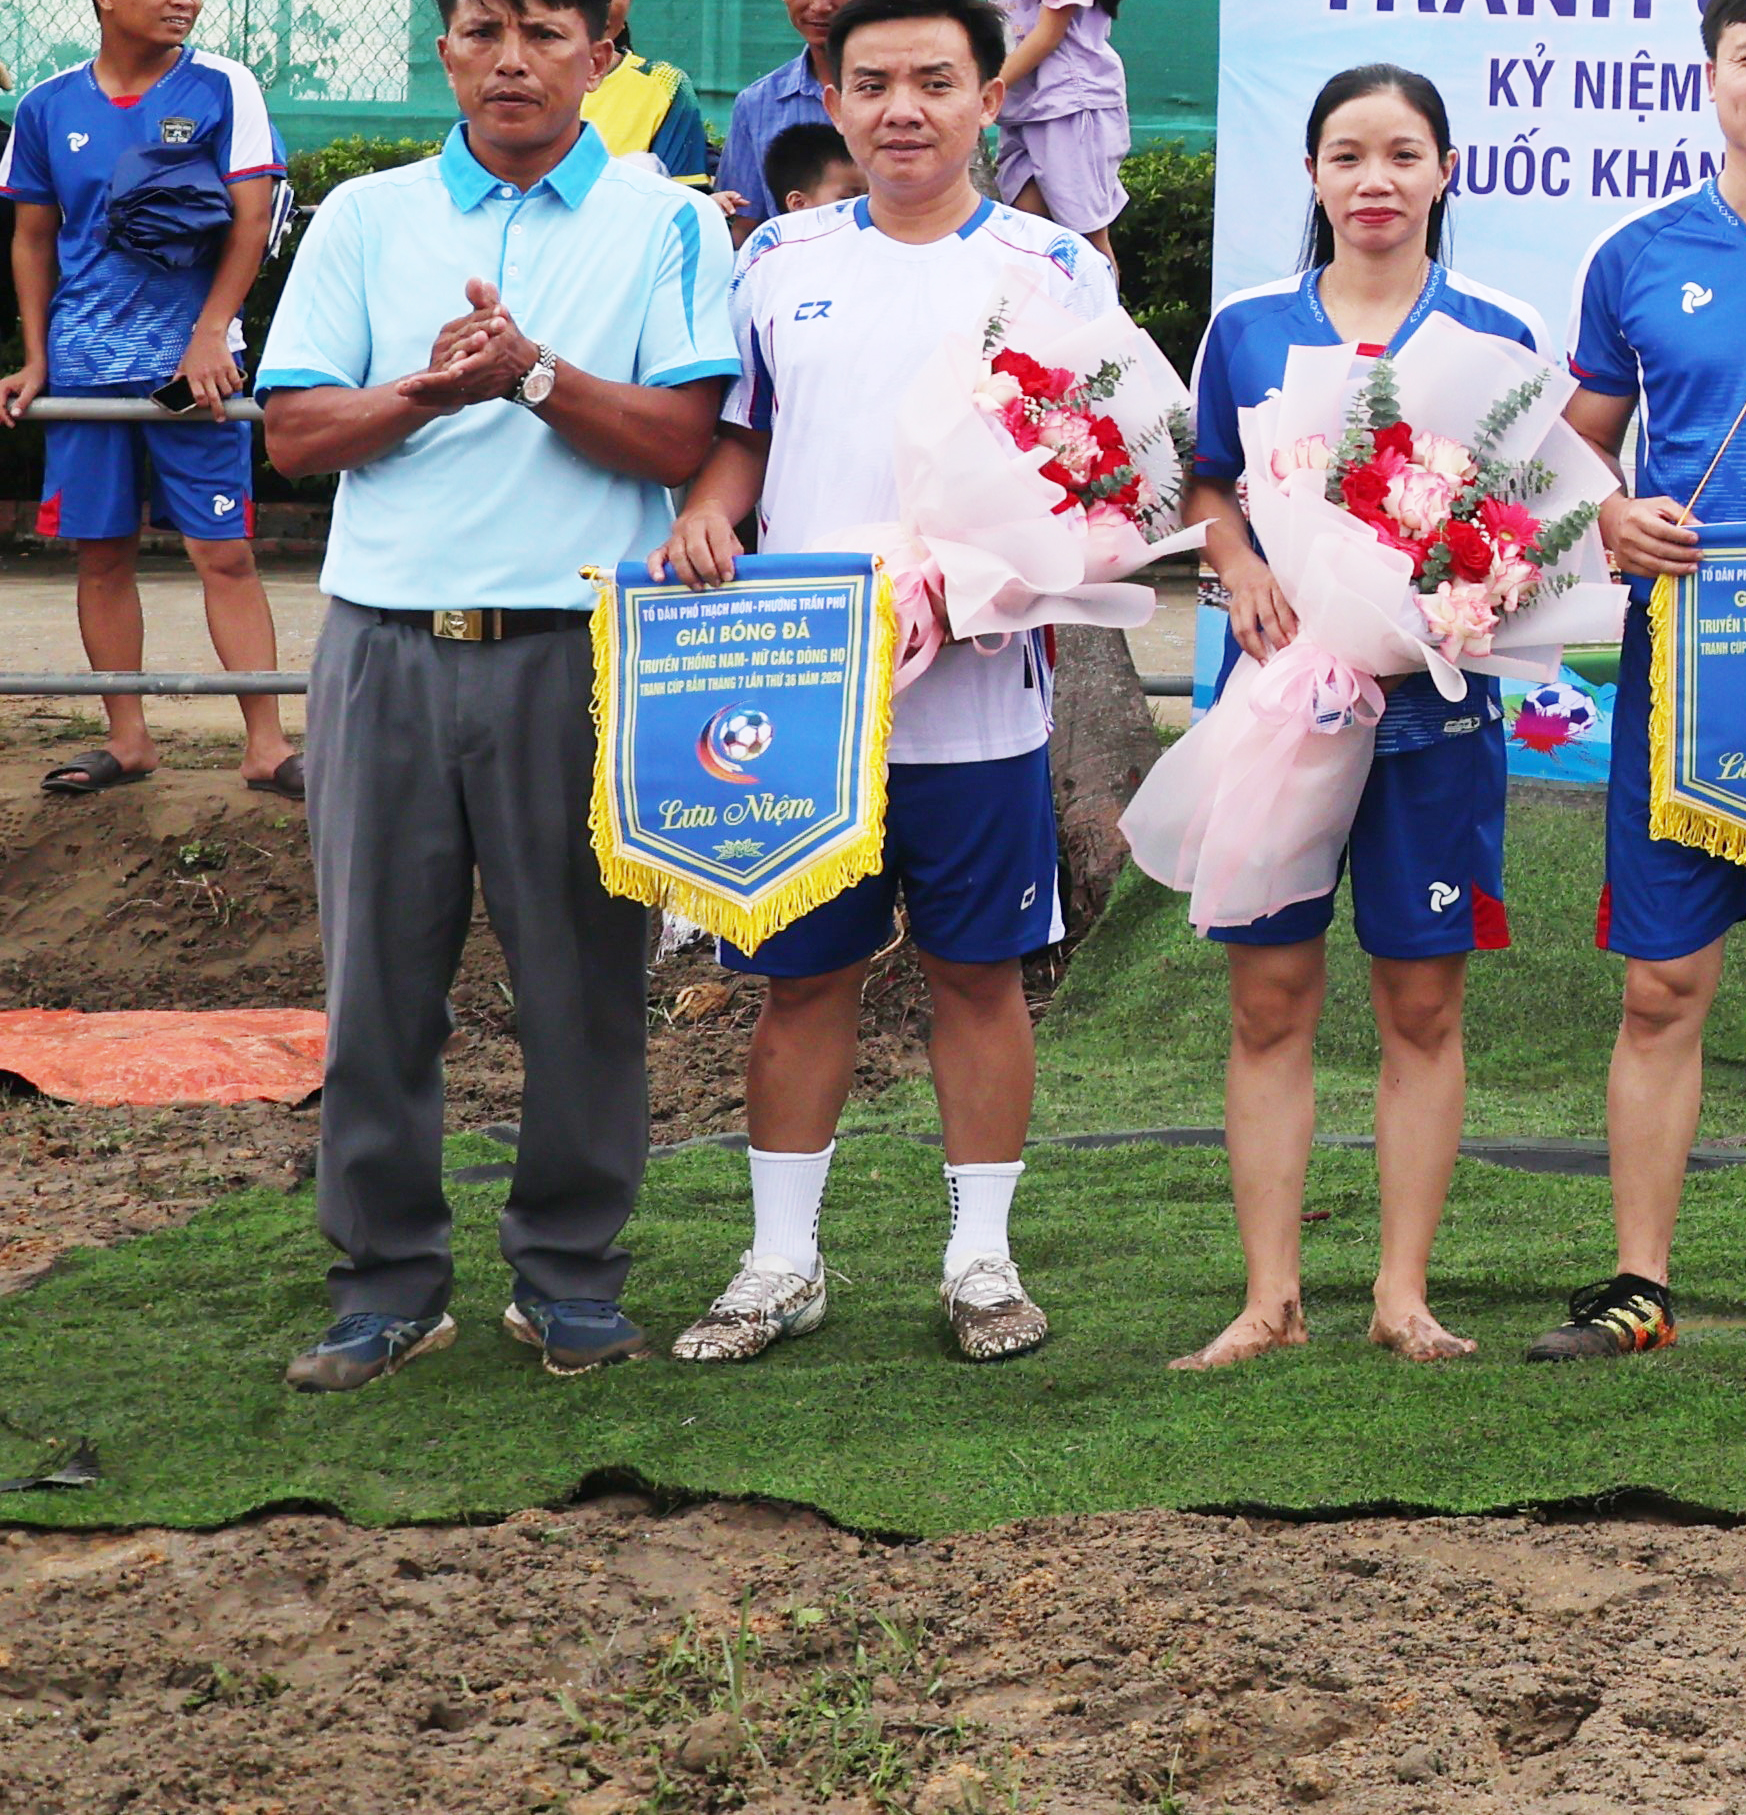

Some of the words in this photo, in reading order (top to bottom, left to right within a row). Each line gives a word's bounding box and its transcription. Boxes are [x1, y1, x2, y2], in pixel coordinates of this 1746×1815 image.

[1490, 43, 1554, 107] KỶ
[1575, 50, 1701, 122] NIỆM
[676, 622, 714, 646] GIẢI
[720, 620, 776, 642] BÓNG
[782, 616, 810, 639] ĐÁ
[659, 799, 716, 831] Lưu
[723, 793, 816, 826] Niệm
